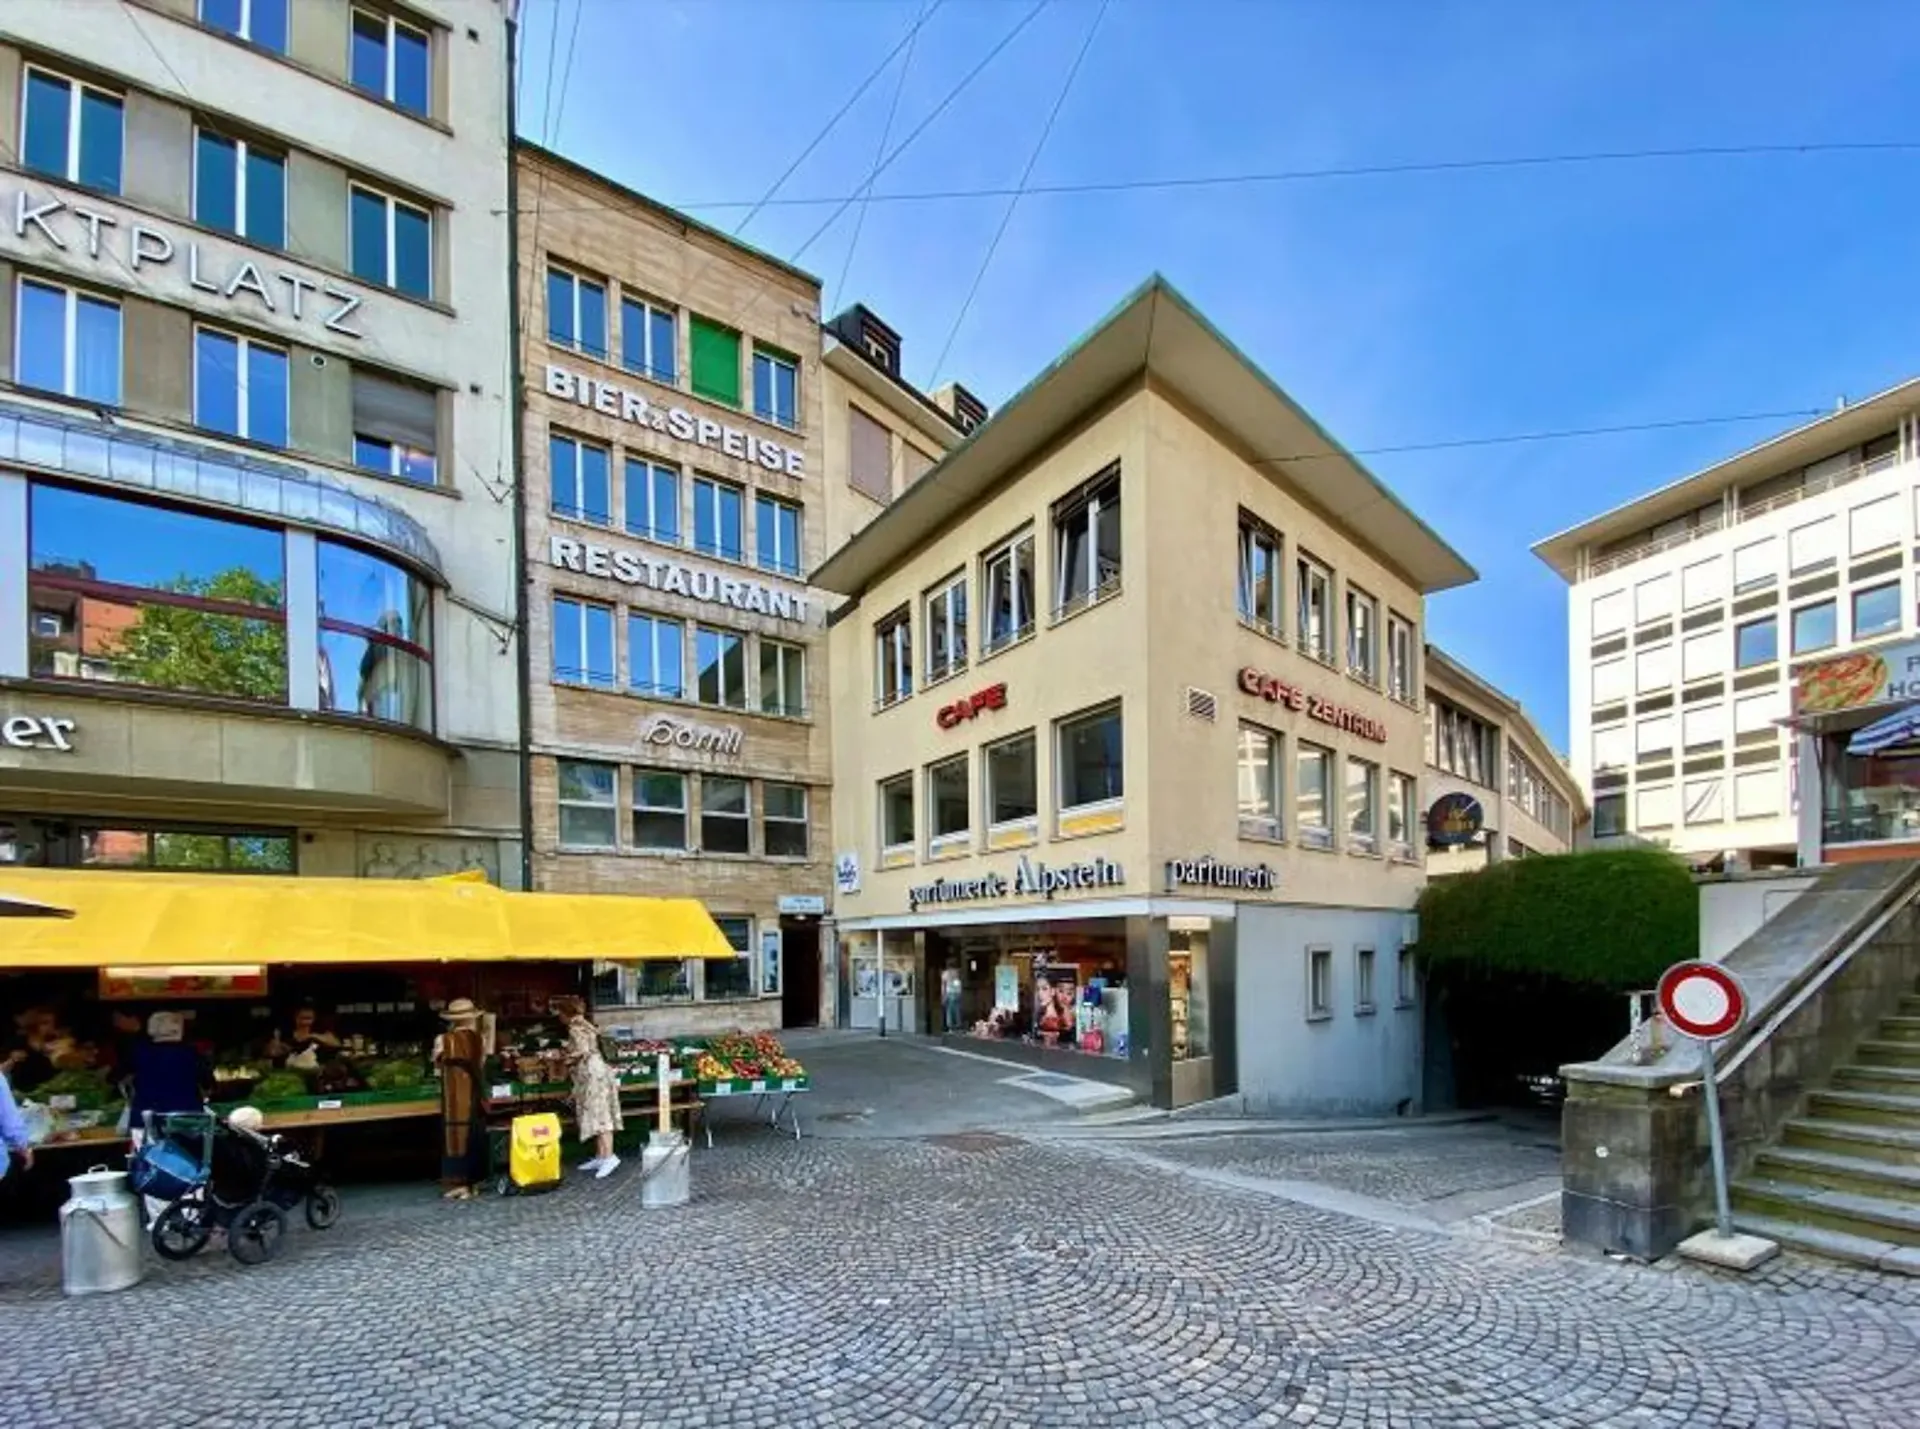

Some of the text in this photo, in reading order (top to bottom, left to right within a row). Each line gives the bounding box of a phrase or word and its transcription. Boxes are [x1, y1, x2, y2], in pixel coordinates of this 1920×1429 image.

[15, 190, 363, 339] KTPLATZ
[545, 364, 650, 428] BIER
[667, 405, 806, 480] SPEISE
[550, 534, 809, 622] RESTAURANT
[2, 716, 75, 752] er
[1237, 666, 1388, 743] CAFE ZENTRUM
